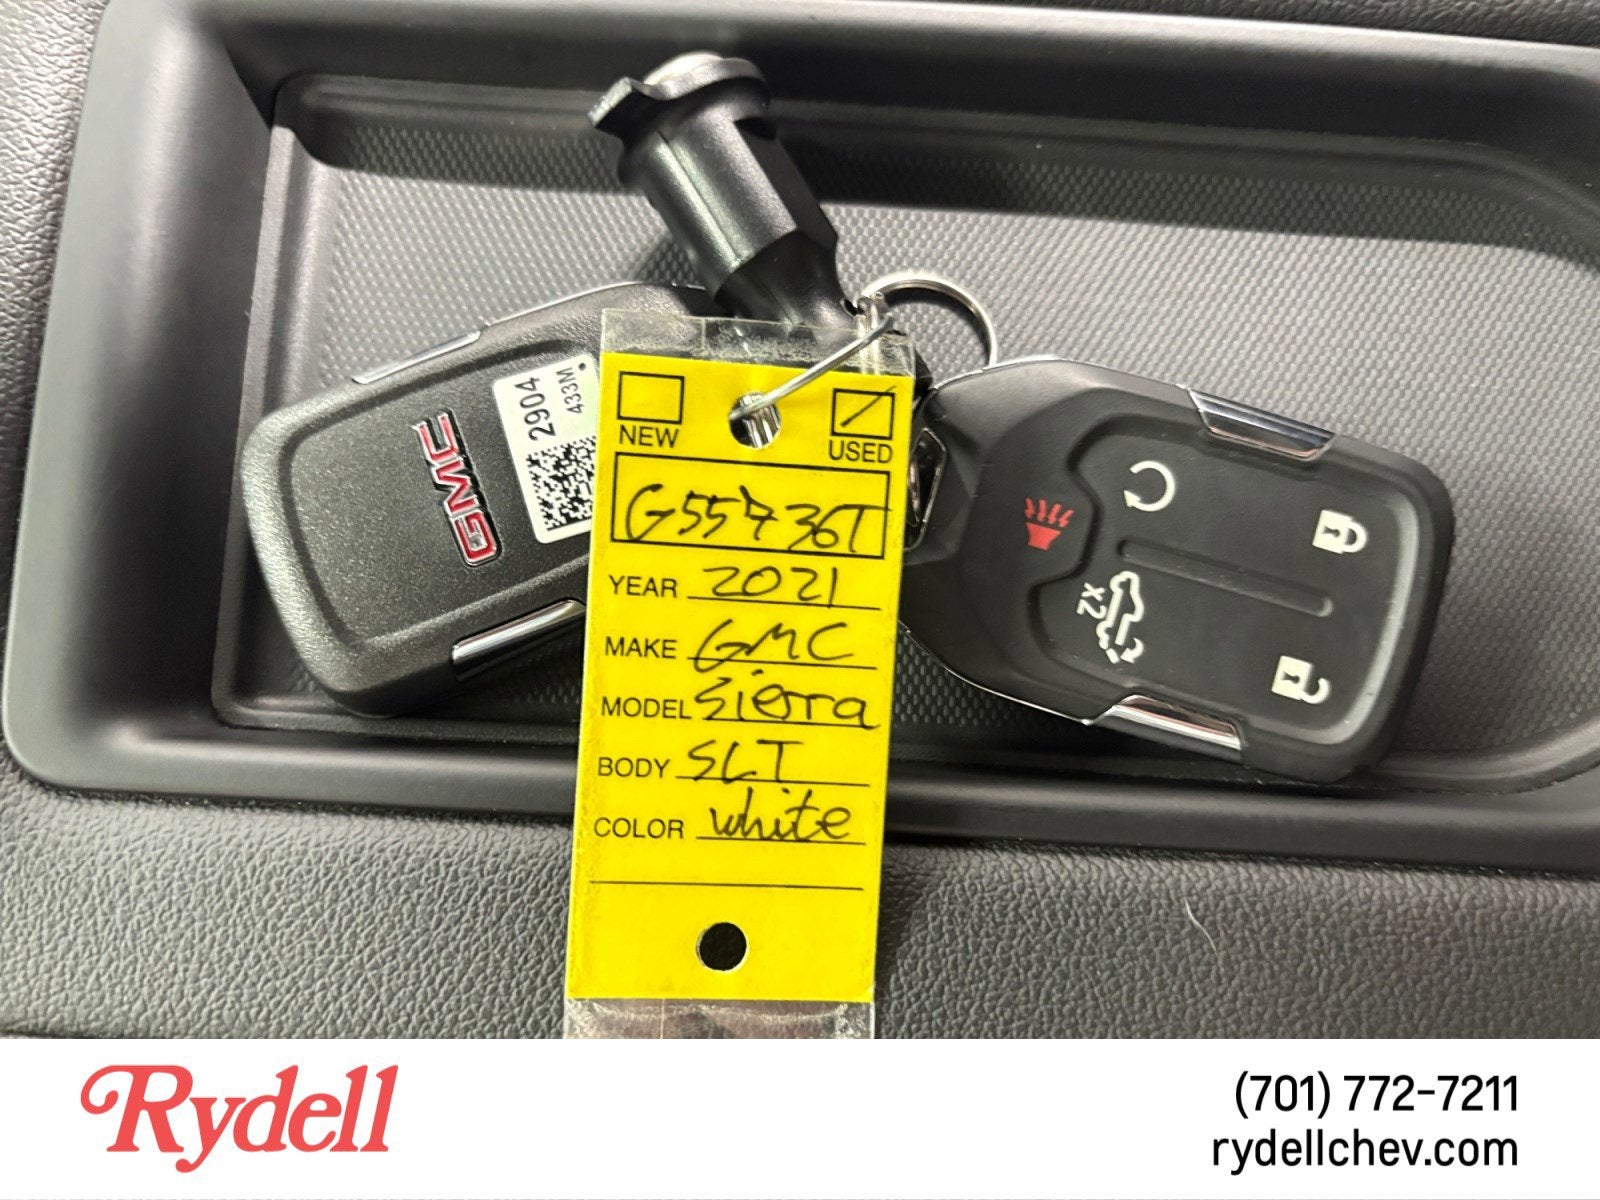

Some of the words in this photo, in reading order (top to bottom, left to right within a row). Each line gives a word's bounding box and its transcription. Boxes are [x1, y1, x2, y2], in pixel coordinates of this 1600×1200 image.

[556, 367, 584, 414] 433M
[514, 376, 556, 441] 2904
[618, 424, 679, 448] NEW
[828, 440, 893, 464] USED
[411, 411, 500, 566] GMC
[609, 575, 678, 599] YEAR
[703, 566, 838, 608] 2021
[604, 636, 677, 659] MAKE
[693, 619, 854, 673] GMC
[600, 696, 692, 720] MODEL
[597, 756, 671, 779] BODY
[687, 739, 804, 784] SLT
[593, 817, 684, 840] COLOR
[709, 786, 851, 842] white
